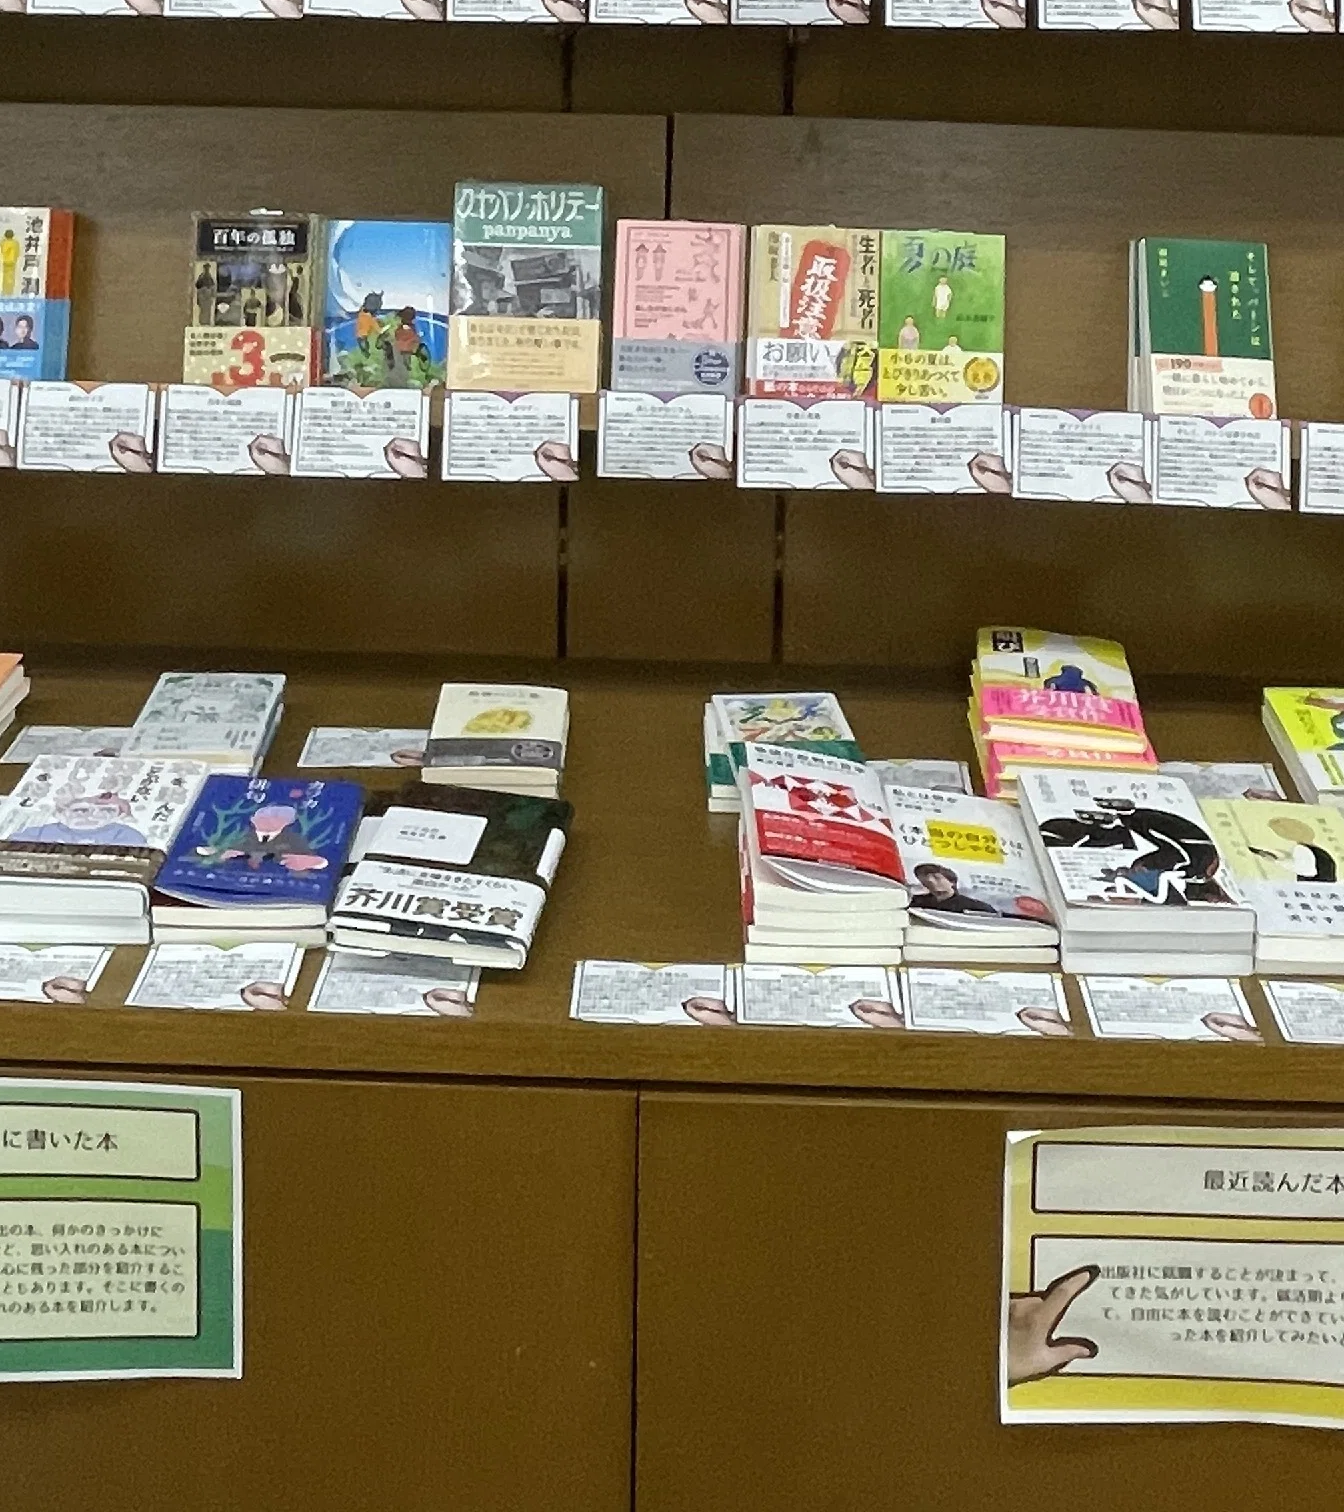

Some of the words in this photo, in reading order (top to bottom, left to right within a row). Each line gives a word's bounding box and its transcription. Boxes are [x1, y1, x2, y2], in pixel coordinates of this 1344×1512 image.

[21, 215, 44, 297] 池井戸潤
[212, 228, 296, 247] 百年の孤独
[483, 224, 573, 242] panpanya
[898, 237, 979, 274] 夏の庭
[791, 254, 839, 340] 取扱注意
[229, 329, 267, 386] 3
